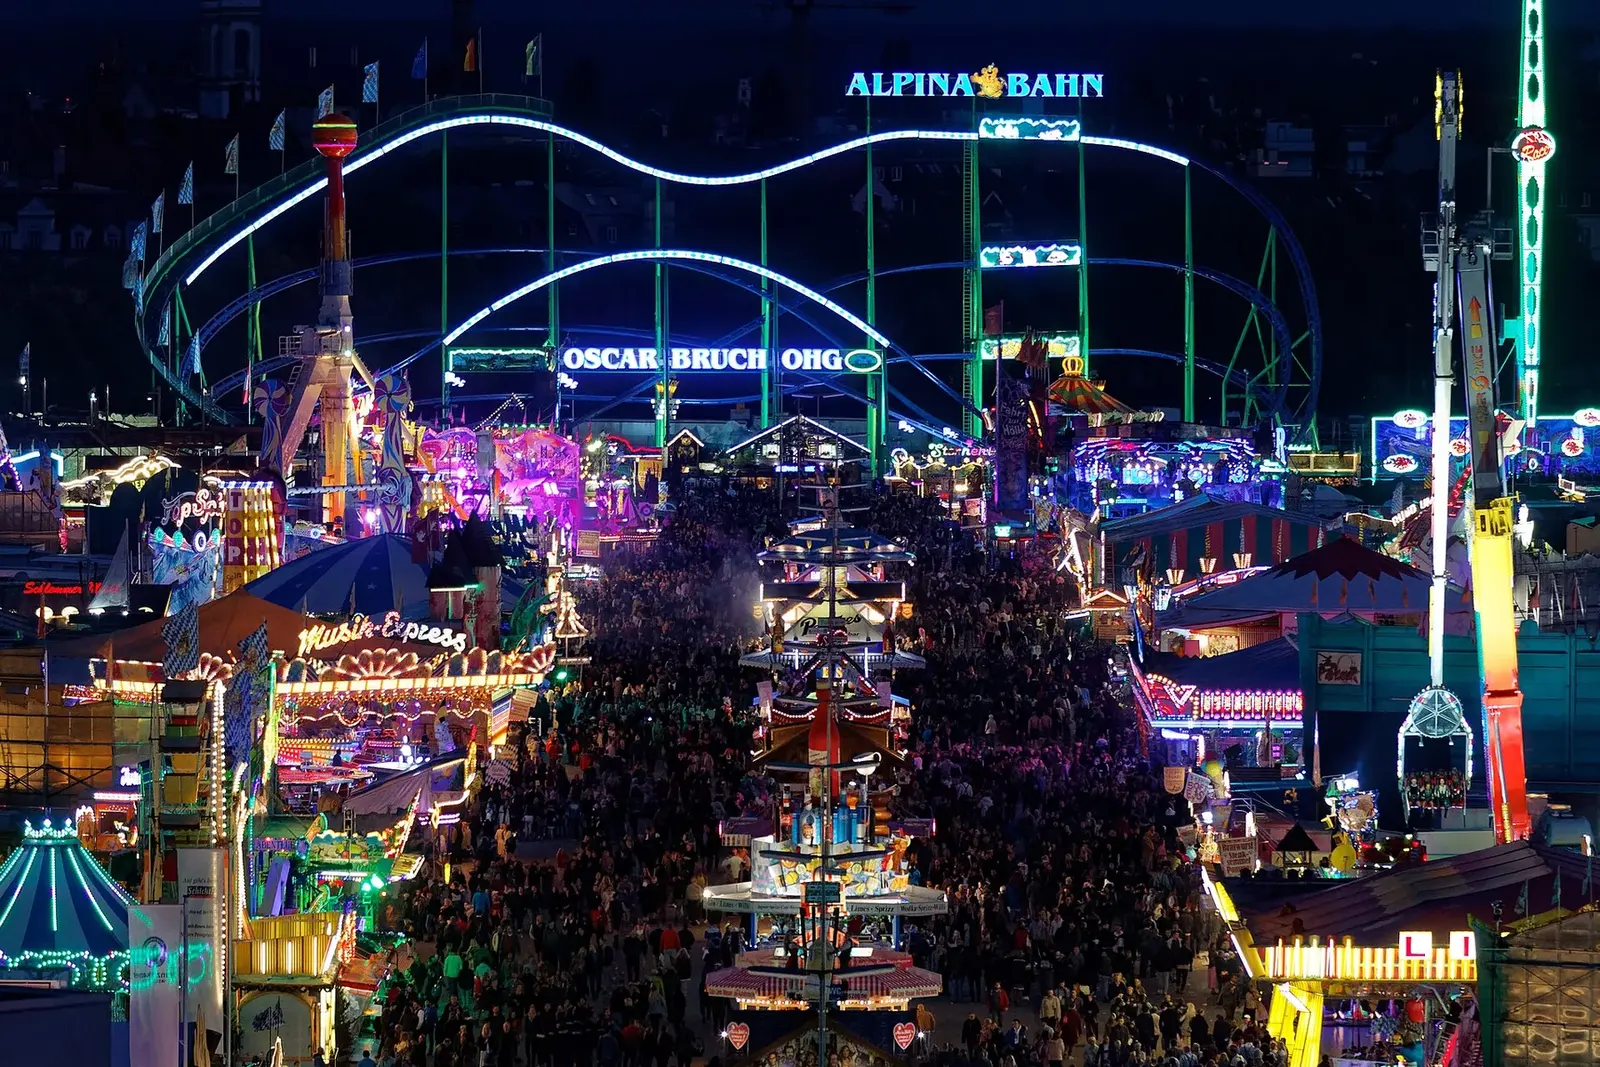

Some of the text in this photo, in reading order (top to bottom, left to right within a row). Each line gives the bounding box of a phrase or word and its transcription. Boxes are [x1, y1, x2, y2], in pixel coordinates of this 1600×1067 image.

[846, 73, 1104, 98] ALPINA BAHN
[563, 348, 844, 370] OSCAR BRUCH OHG
[850, 904, 895, 913] Limes Sprizz
